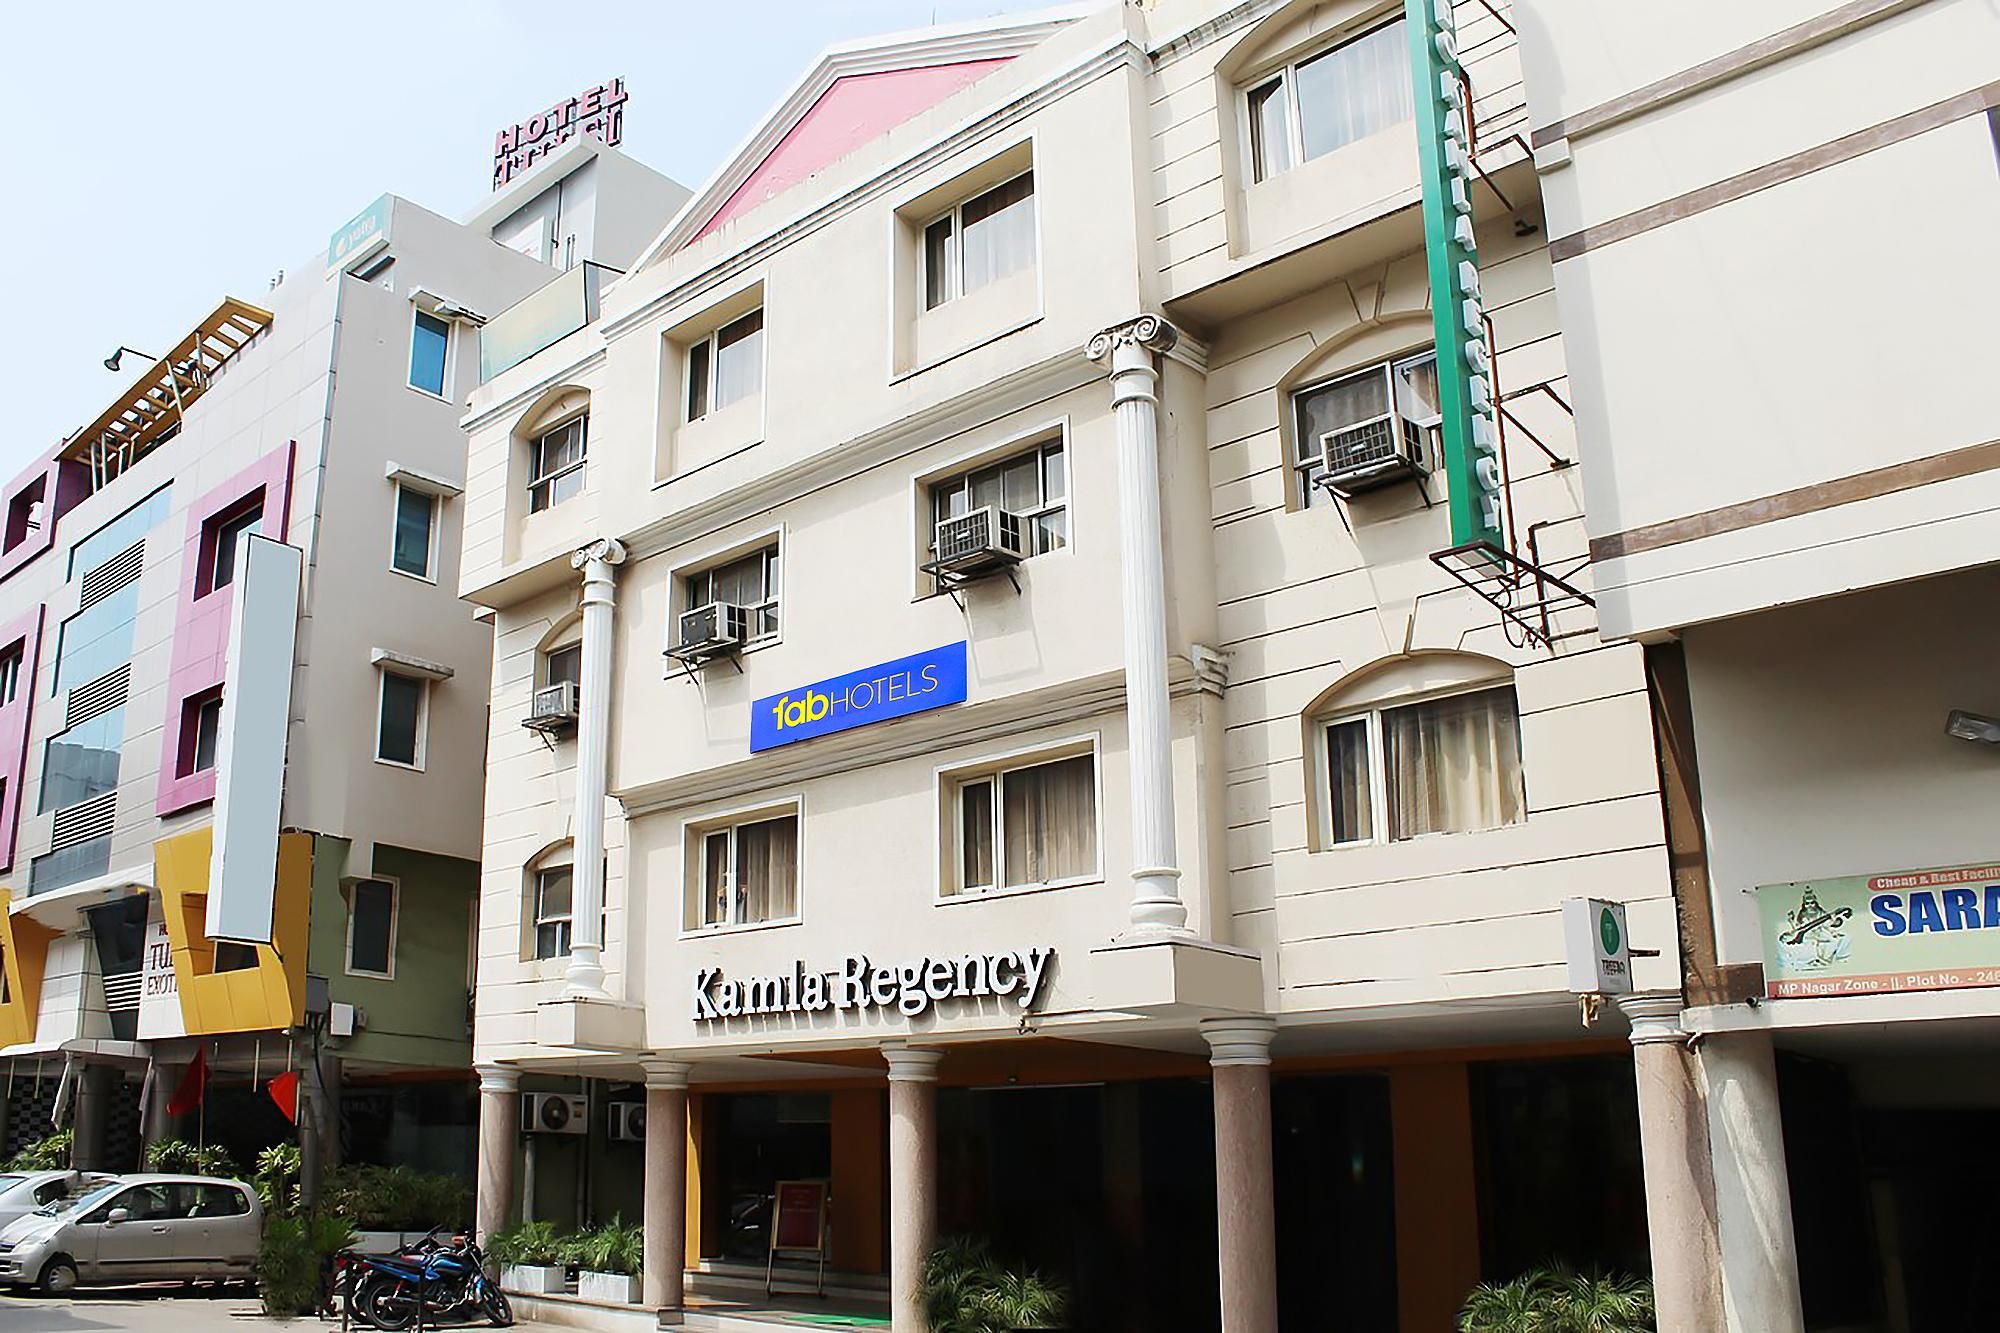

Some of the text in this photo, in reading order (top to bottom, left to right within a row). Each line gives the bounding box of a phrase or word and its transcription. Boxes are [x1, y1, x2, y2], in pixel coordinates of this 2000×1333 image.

[495, 78, 628, 160] HOTEL
[772, 664, 939, 731] fabHOTELS
[1877, 875, 1917, 889] Cheap
[1931, 871, 1960, 884] Best
[692, 947, 1056, 1020] Kamla Regency
[1779, 983, 1798, 995] MP
[1801, 981, 1841, 995] Nagar
[1844, 979, 1879, 991] Zone
[1906, 975, 1937, 987] Plot
[1939, 973, 1964, 985] No.
